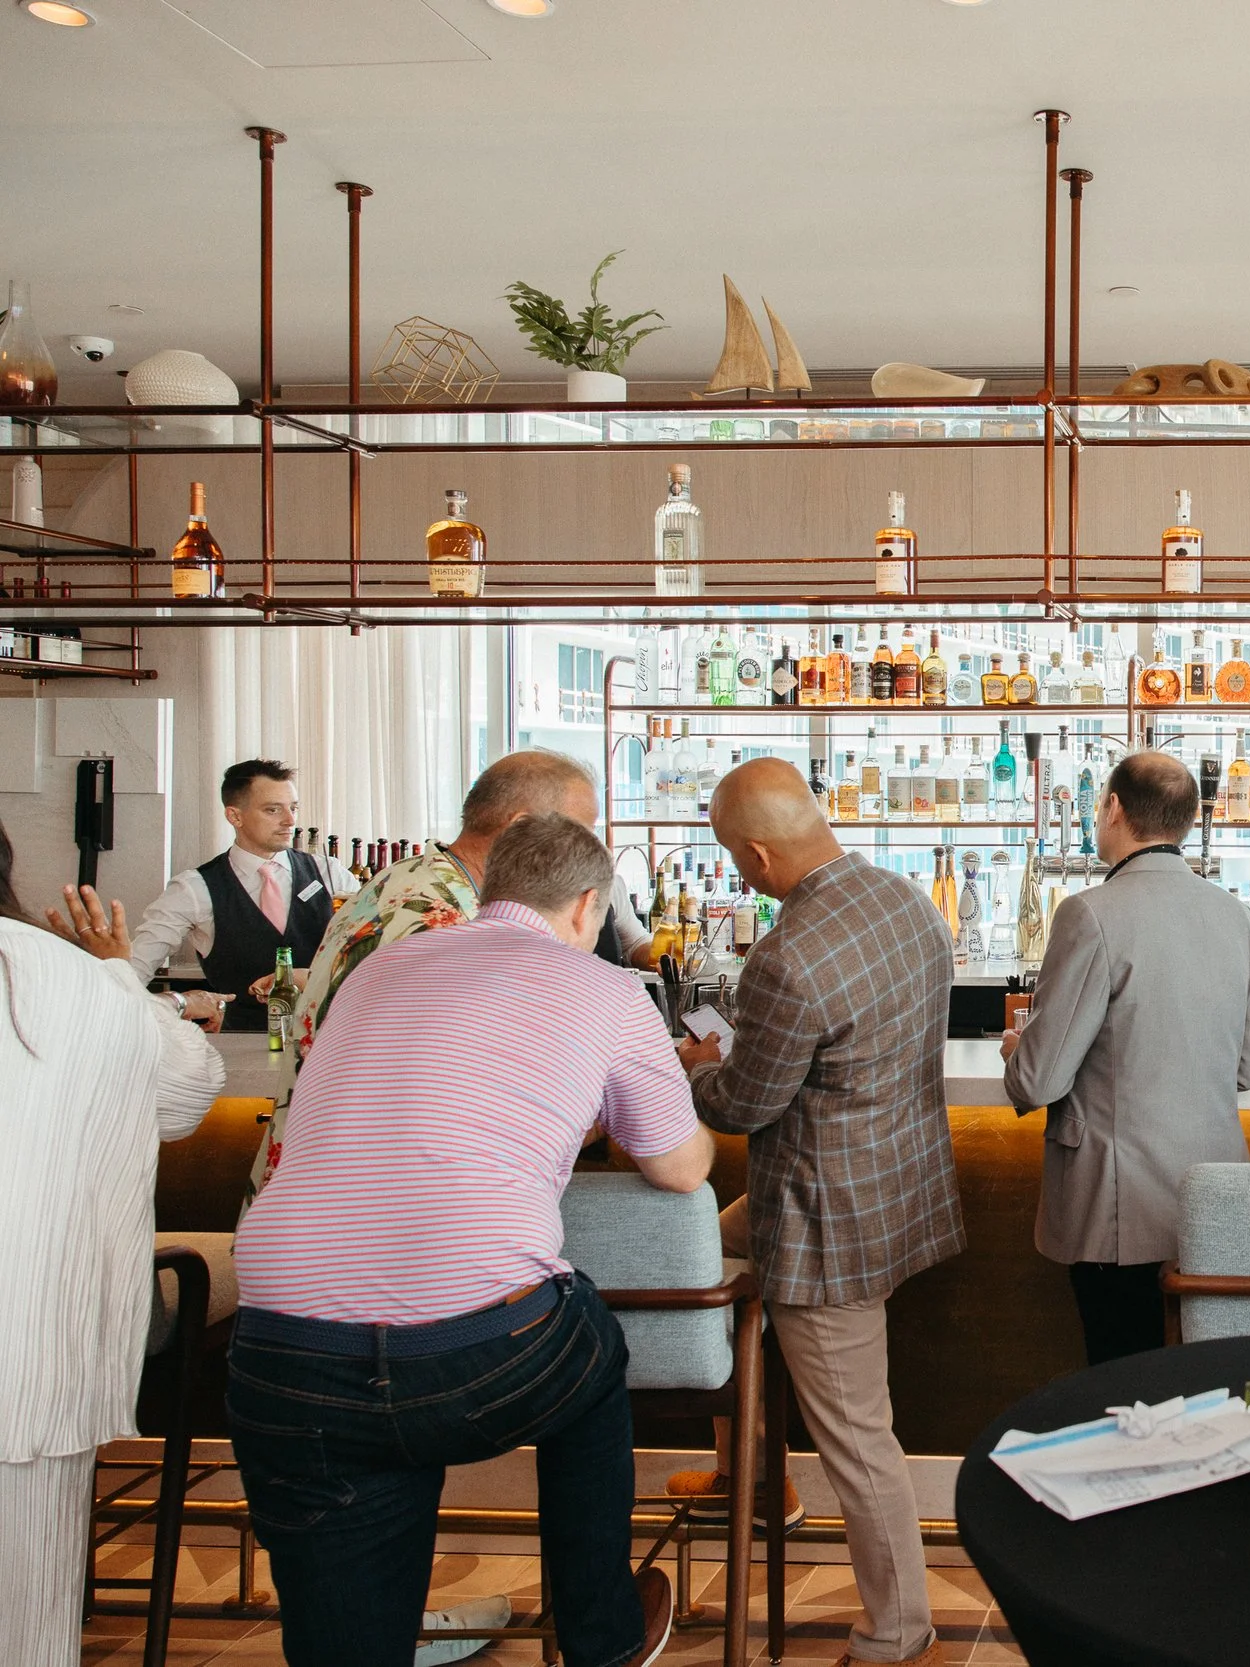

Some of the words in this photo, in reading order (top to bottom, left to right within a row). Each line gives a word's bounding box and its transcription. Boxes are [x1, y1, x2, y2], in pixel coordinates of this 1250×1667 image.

[636, 647, 651, 692] Chopin
[661, 660, 673, 671] elit
[1043, 763, 1051, 795] ULTRA
[1080, 789, 1088, 817] KONA
